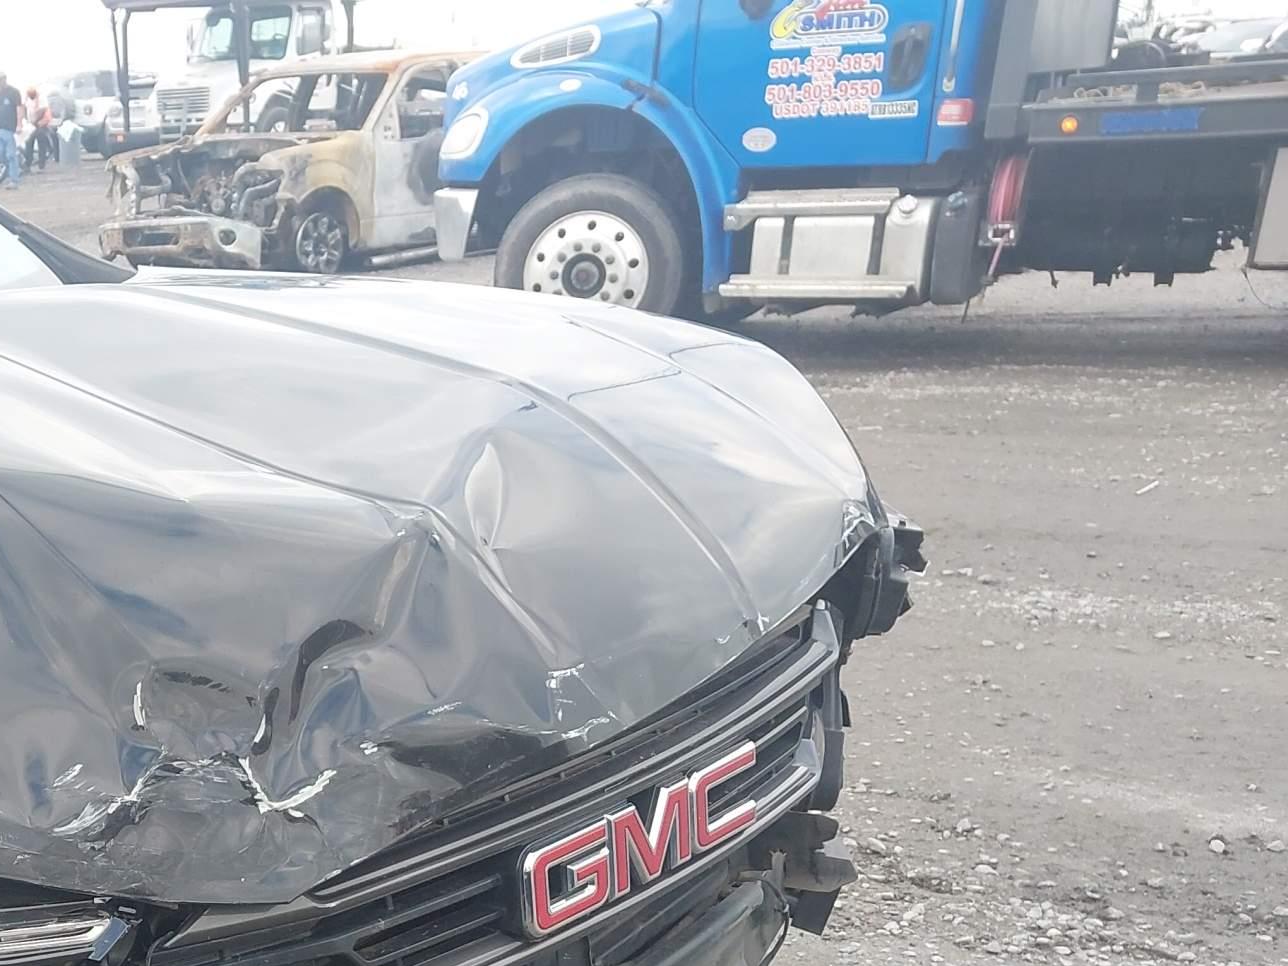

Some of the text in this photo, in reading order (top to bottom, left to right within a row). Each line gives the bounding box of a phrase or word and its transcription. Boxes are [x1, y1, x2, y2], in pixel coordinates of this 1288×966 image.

[799, 10, 876, 32] SMITH
[770, 54, 883, 76] 501-329-3851
[767, 82, 880, 102] 501-803-9550
[775, 103, 818, 116] USDOT
[521, 740, 757, 941] GMC
